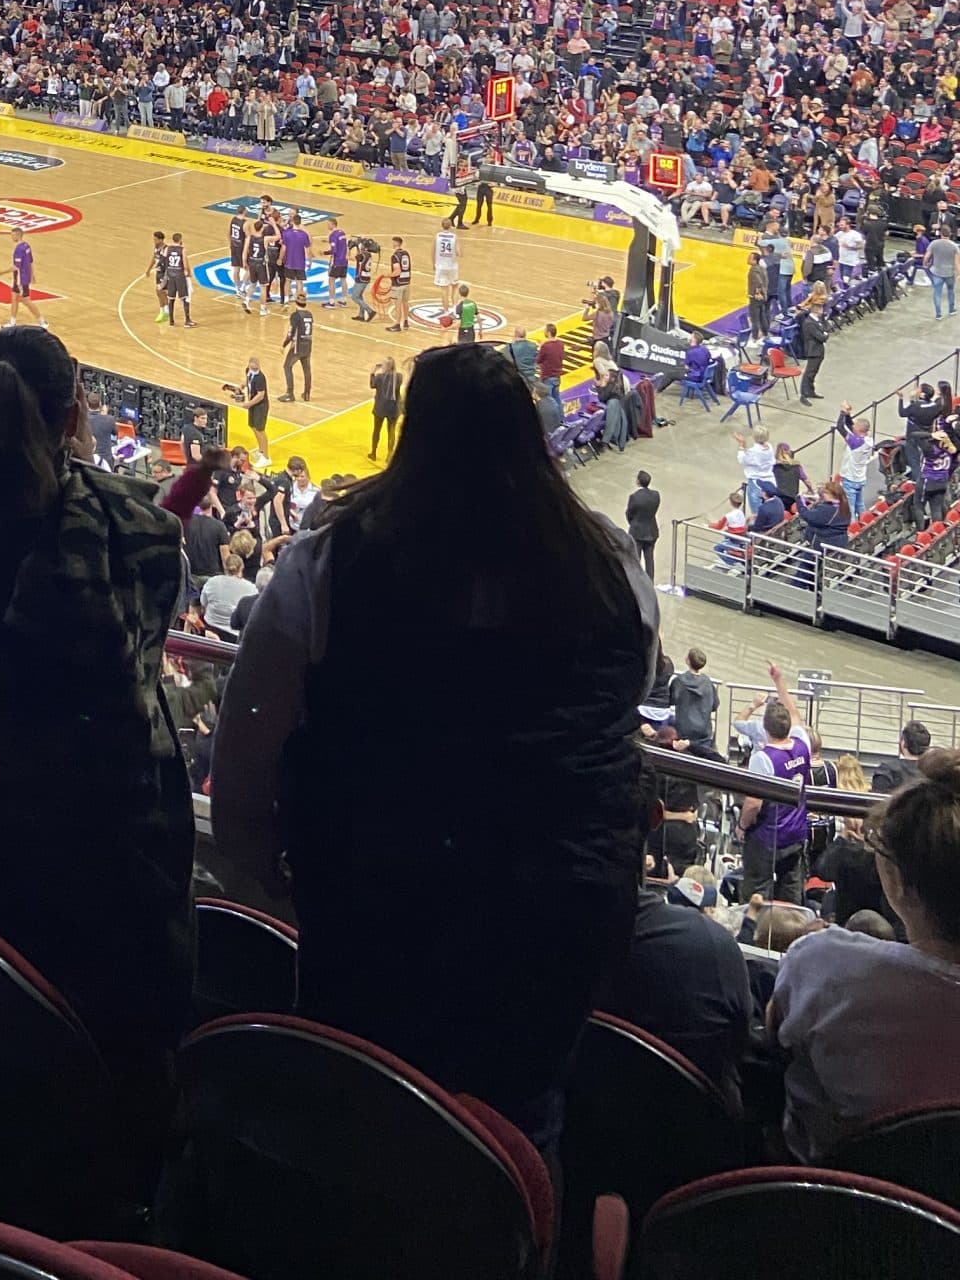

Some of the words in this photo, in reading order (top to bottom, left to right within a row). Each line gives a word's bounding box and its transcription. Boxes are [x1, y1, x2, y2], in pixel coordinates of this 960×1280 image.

[303, 158, 312, 166] WE
[313, 159, 324, 168] ARE
[325, 160, 334, 169] ALL
[335, 162, 353, 172] KINGS
[575, 161, 607, 173] brydens
[497, 192, 510, 202] ARE
[511, 193, 522, 203] ALL
[524, 195, 544, 207] KINGS
[231, 228, 240, 239] 13
[440, 242, 452, 253] 34
[791, 241, 811, 253] KING
[168, 256, 180, 267] 97
[650, 344, 678, 356] Qudos
[649, 353, 676, 365] Arena
[933, 456, 950, 470] 30
